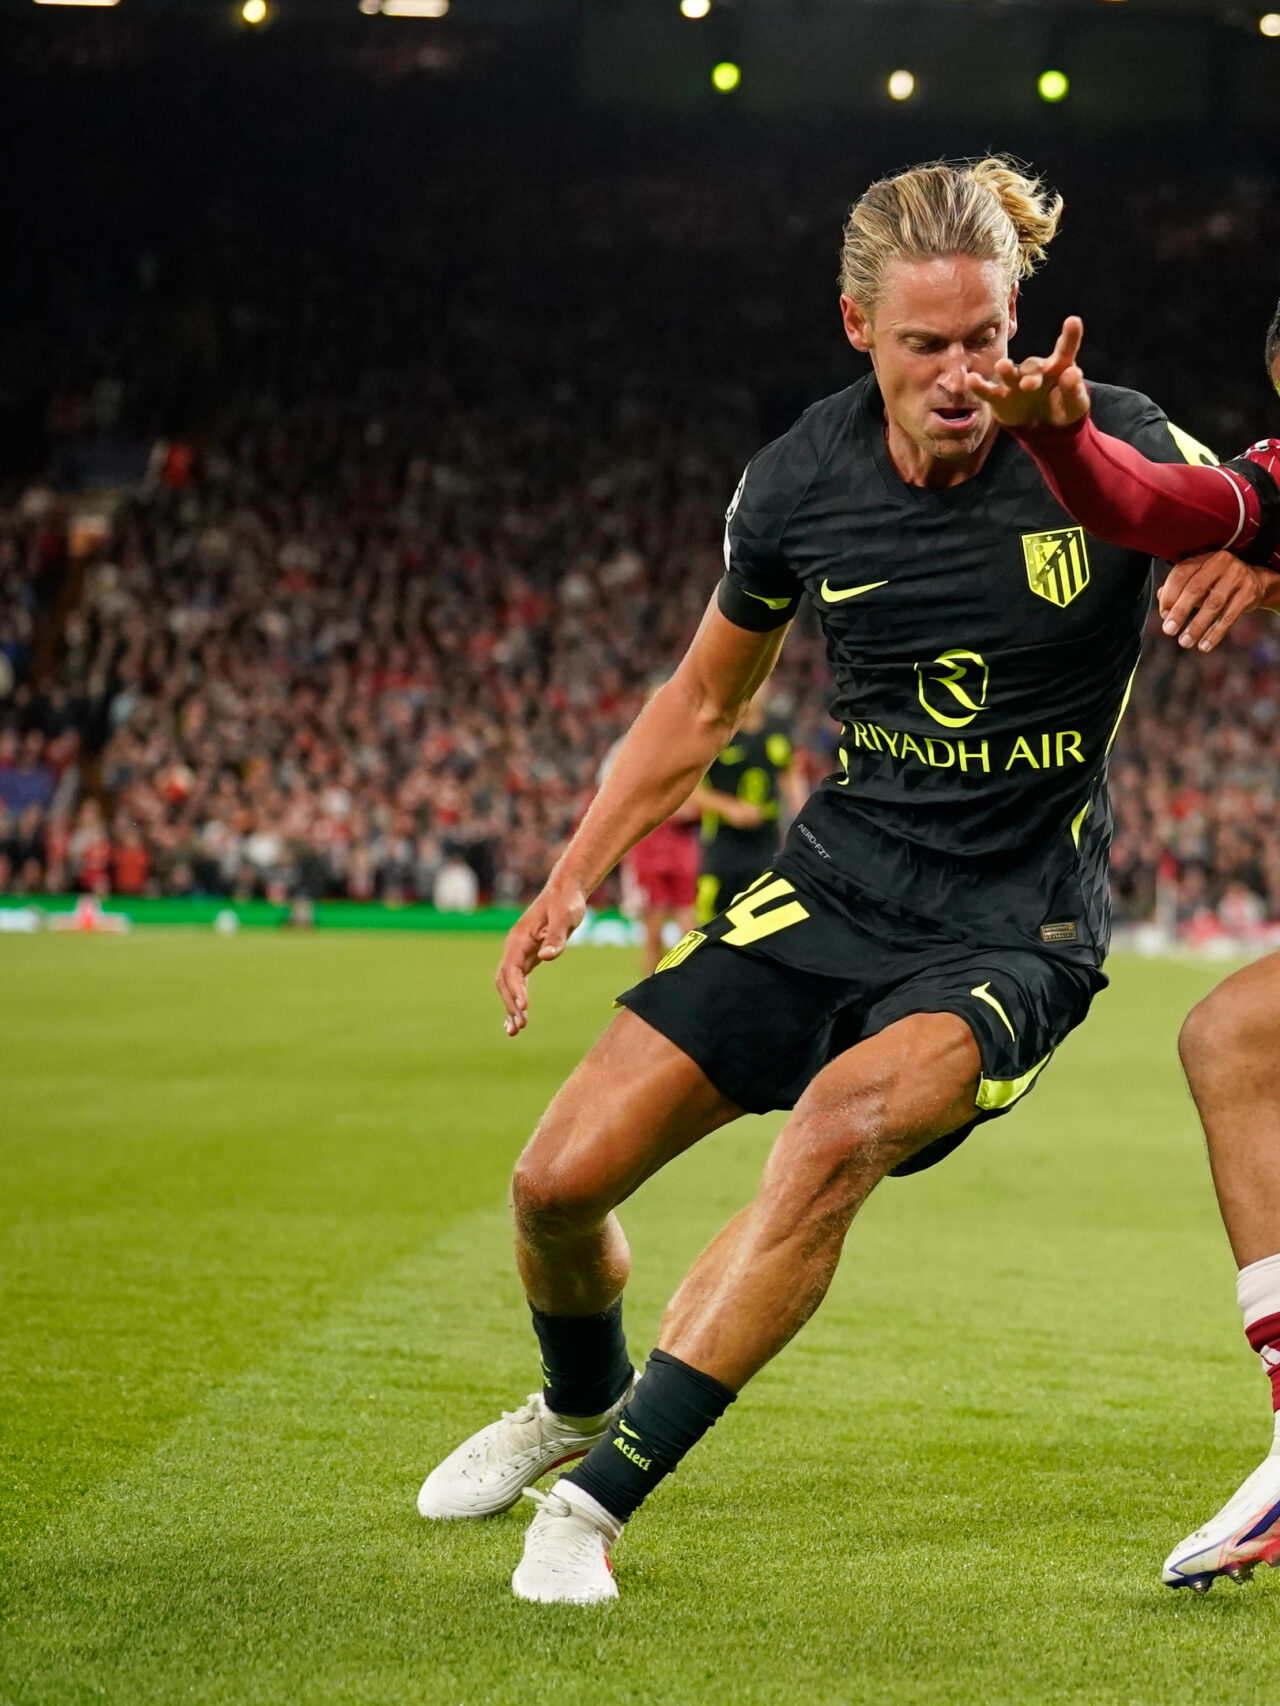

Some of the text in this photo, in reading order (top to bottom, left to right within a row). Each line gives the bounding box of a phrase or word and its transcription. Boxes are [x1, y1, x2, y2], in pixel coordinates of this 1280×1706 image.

[849, 720, 1086, 773] RIYADH AIR
[798, 823, 832, 859] AERO-FIT
